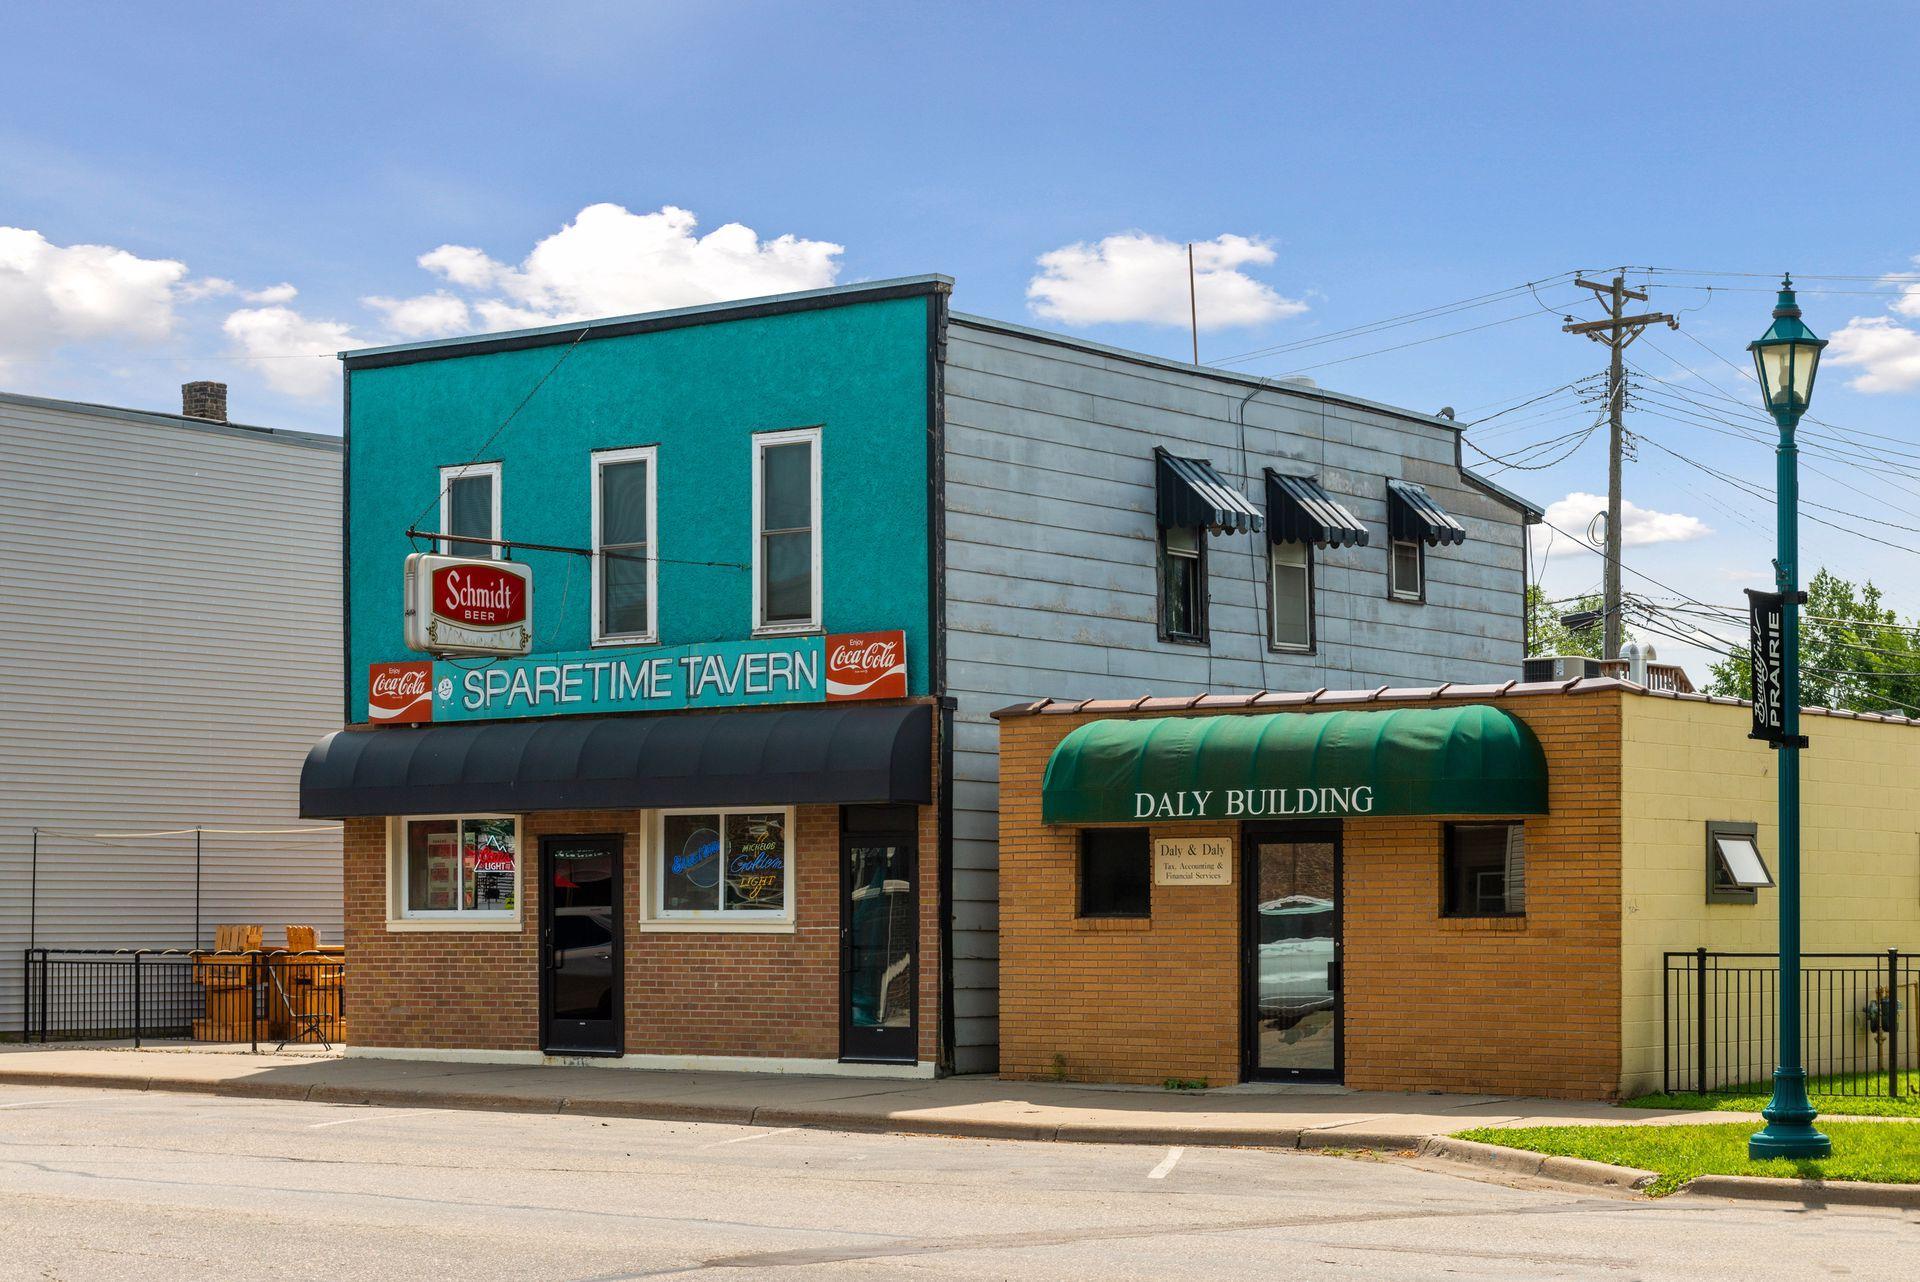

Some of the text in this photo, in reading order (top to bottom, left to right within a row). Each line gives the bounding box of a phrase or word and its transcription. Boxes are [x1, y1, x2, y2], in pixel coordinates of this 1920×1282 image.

[446, 570, 512, 610] Schmidt
[464, 610, 495, 621] BEER
[849, 638, 864, 647] Enjoy
[830, 641, 898, 672] Coca-Cola
[388, 667, 400, 675] Enjoy
[1752, 608, 1768, 727] Beautiful
[1768, 611, 1780, 727] PRAIRIE
[372, 670, 428, 697] Coca-Cola
[464, 650, 818, 710] SPARETIME TAVERN
[1134, 785, 1374, 818] DALY BUILDING
[1160, 843, 1225, 858] Daly & Daly
[485, 862, 506, 871] LIGHT
[731, 852, 784, 872] Golden
[1179, 861, 1215, 870] Accounting
[1216, 861, 1224, 870] &
[1165, 871, 1221, 880] Financial Services
